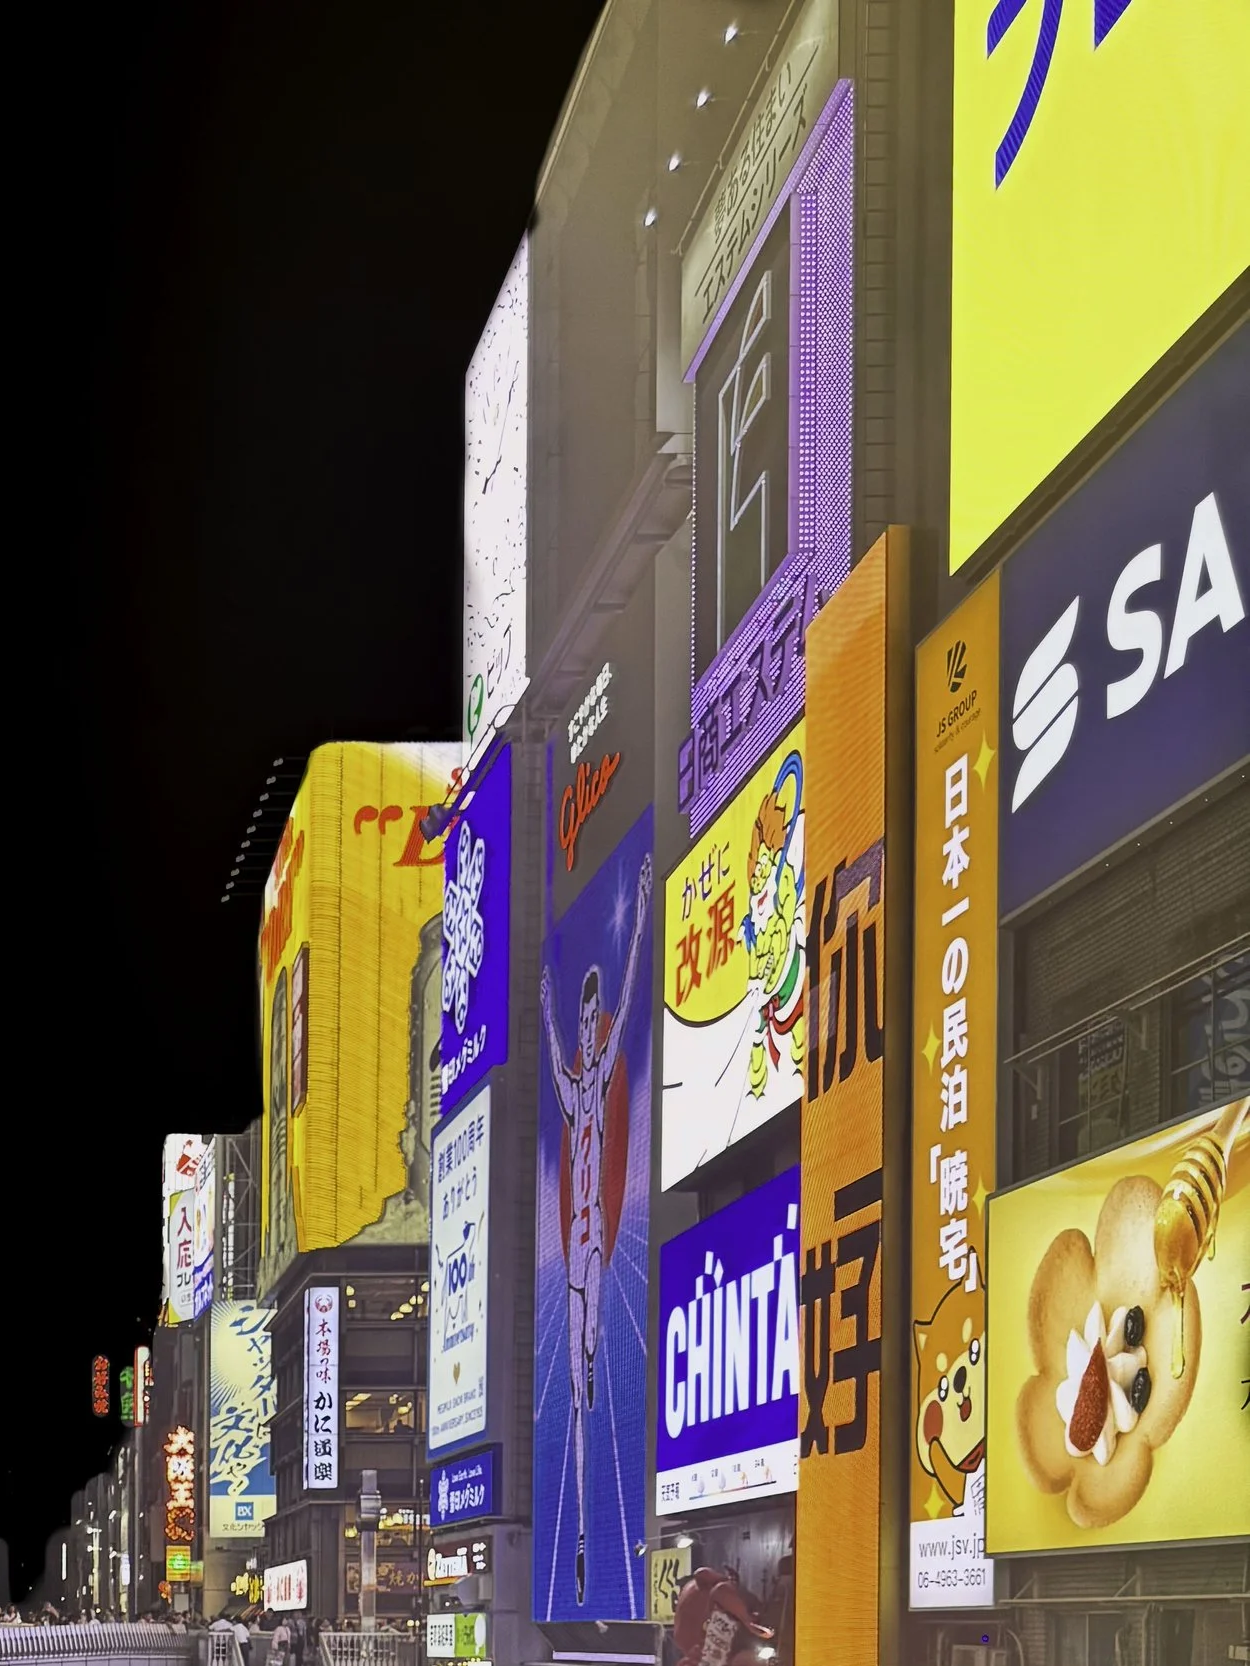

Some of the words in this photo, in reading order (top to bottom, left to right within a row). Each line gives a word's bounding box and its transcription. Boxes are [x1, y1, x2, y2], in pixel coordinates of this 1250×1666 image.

[1107, 492, 1247, 719] SA
[936, 717, 947, 738] JS
[947, 689, 978, 727] GROUP
[559, 751, 621, 873] Glico
[681, 841, 731, 923] かぜに
[675, 880, 740, 1007] 改源
[939, 752, 971, 1132] 日本一の民泊
[442, 1164, 479, 1222] ありがとう
[580, 1113, 594, 1246] グリコ
[313, 1391, 333, 1481] かに道楽
[918, 1532, 986, 1561] www.jsv.jp
